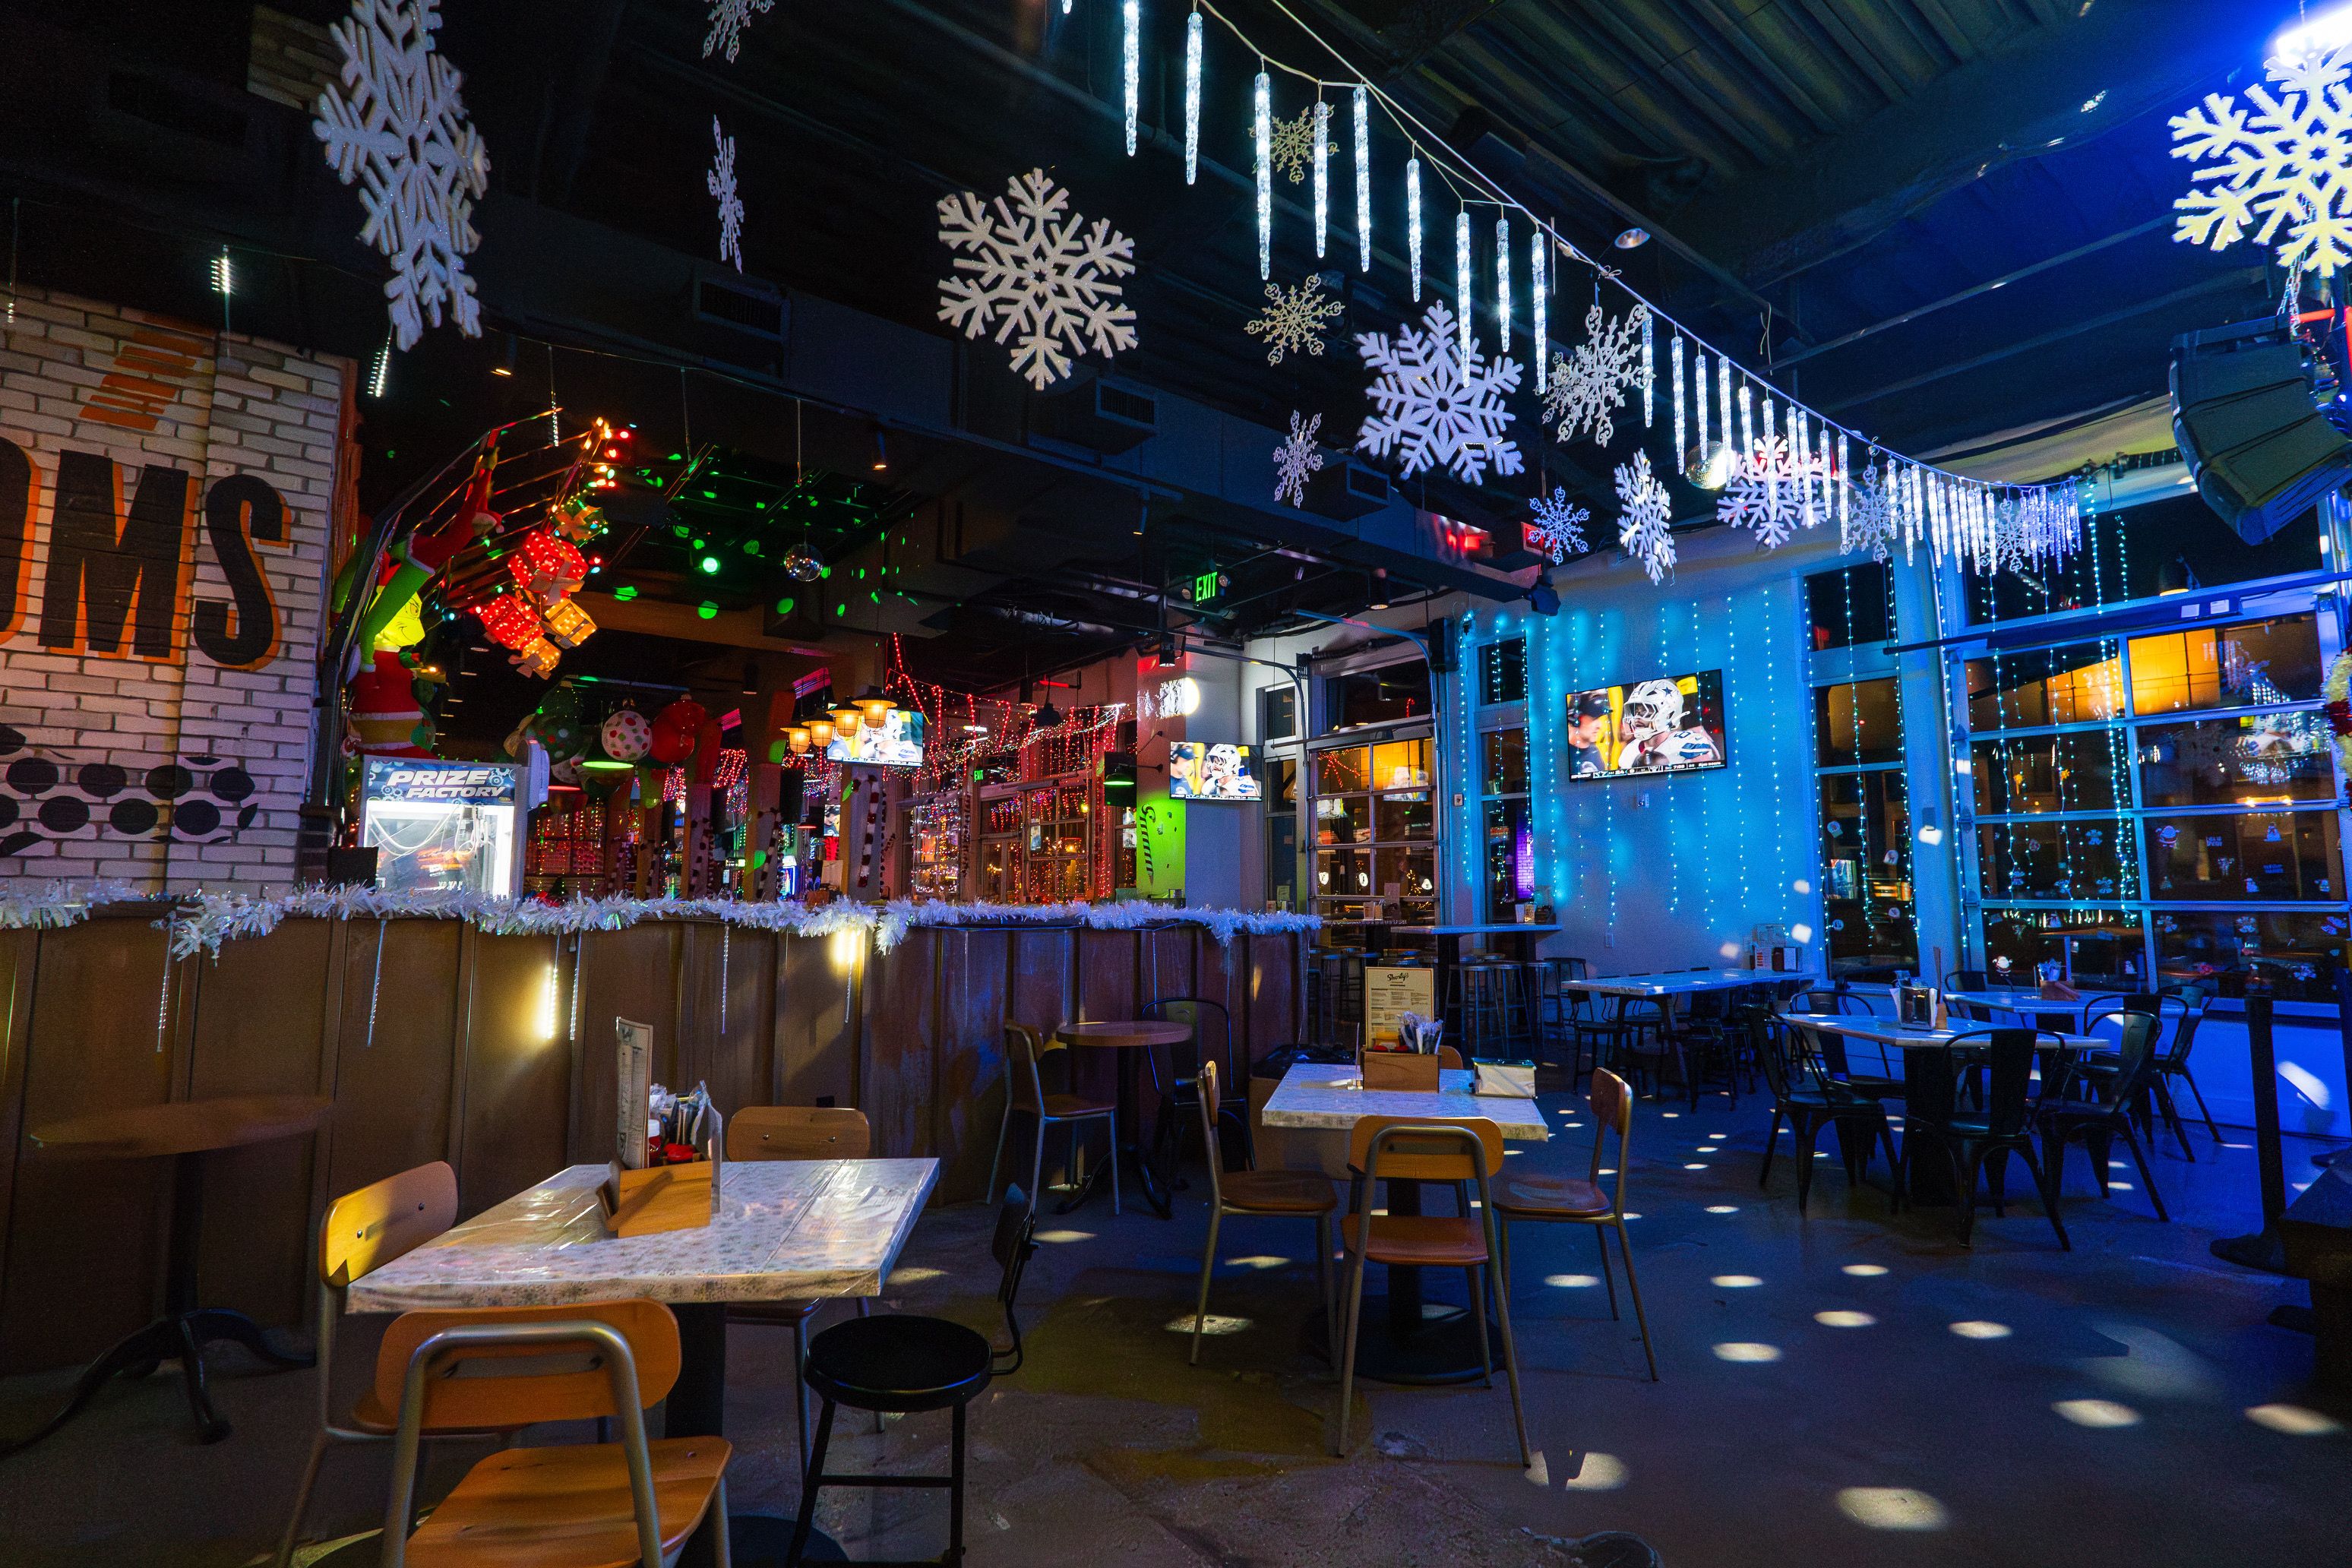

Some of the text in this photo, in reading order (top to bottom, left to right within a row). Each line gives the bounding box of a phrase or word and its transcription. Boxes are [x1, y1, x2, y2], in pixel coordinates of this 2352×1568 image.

[1196, 571, 1218, 602] EXIT
[386, 770, 492, 786] PRIZE
[974, 770, 984, 781] EXIT
[406, 786, 507, 798] FACTORY
